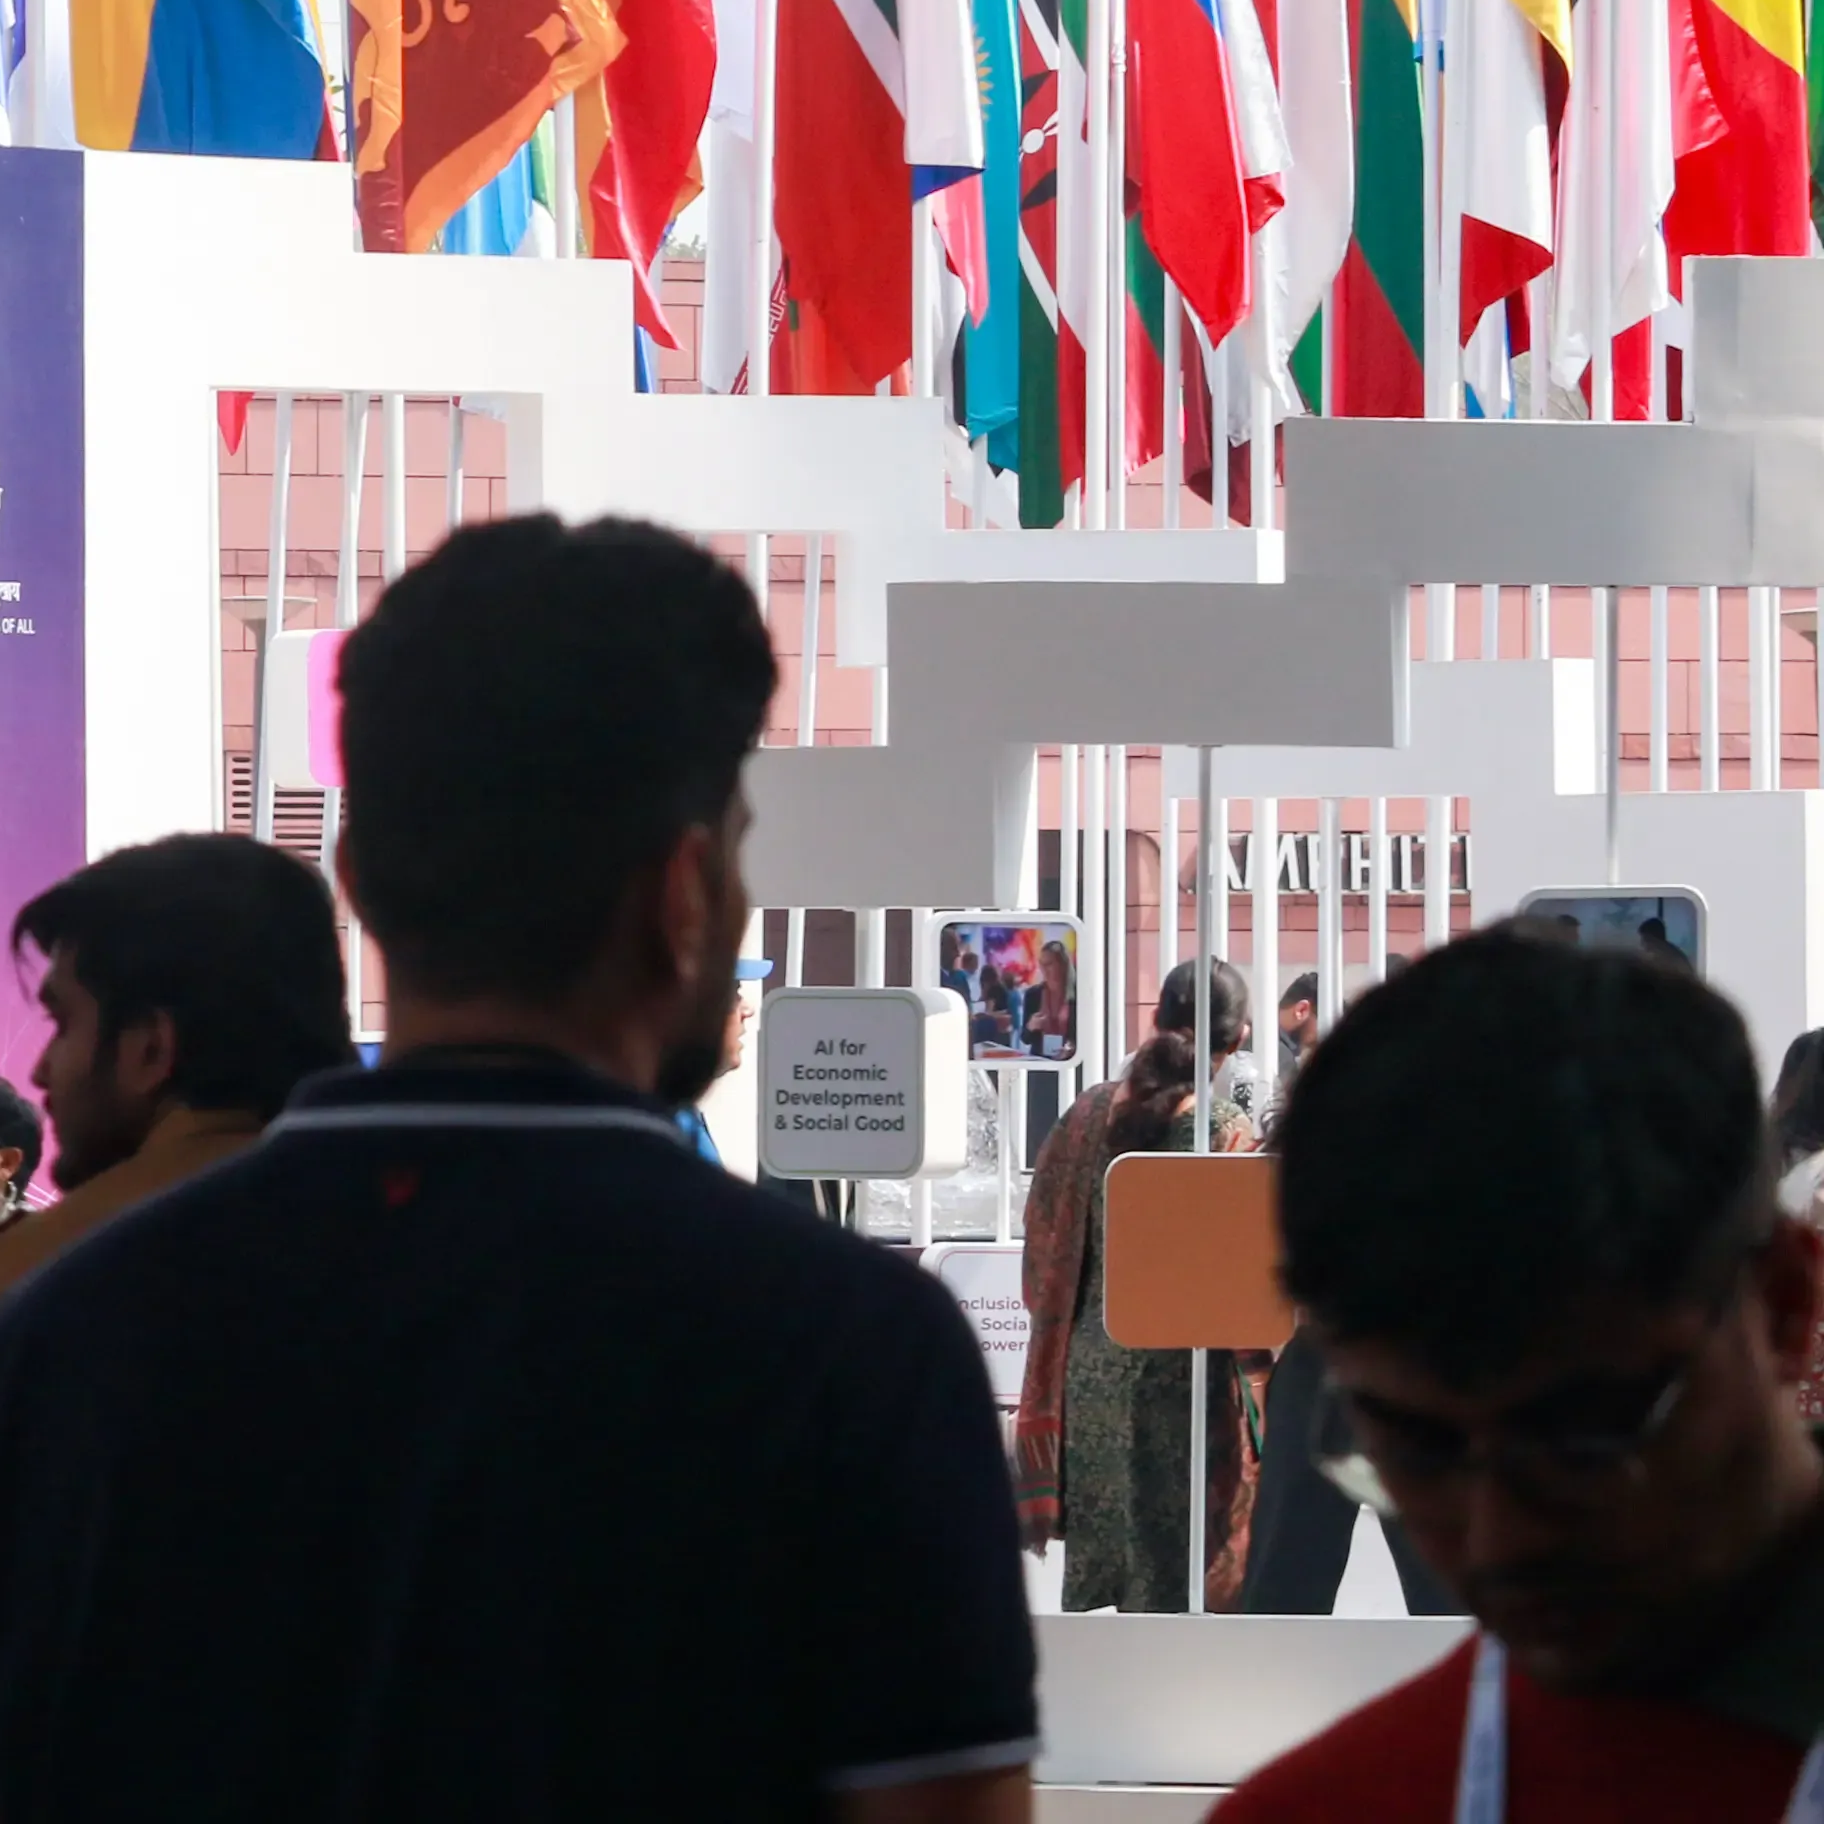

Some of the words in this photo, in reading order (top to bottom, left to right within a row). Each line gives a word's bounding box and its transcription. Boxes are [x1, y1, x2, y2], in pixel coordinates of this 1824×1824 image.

[1, 618, 16, 634] OF
[16, 618, 36, 635] ALL
[814, 1039, 834, 1056] AI
[839, 1038, 867, 1056] for
[792, 1064, 889, 1081] Economic
[775, 1089, 906, 1109] Development
[774, 1114, 788, 1130] &
[792, 1113, 849, 1131] Social
[854, 1114, 906, 1132] Good
[958, 1296, 1027, 1310] nclusio
